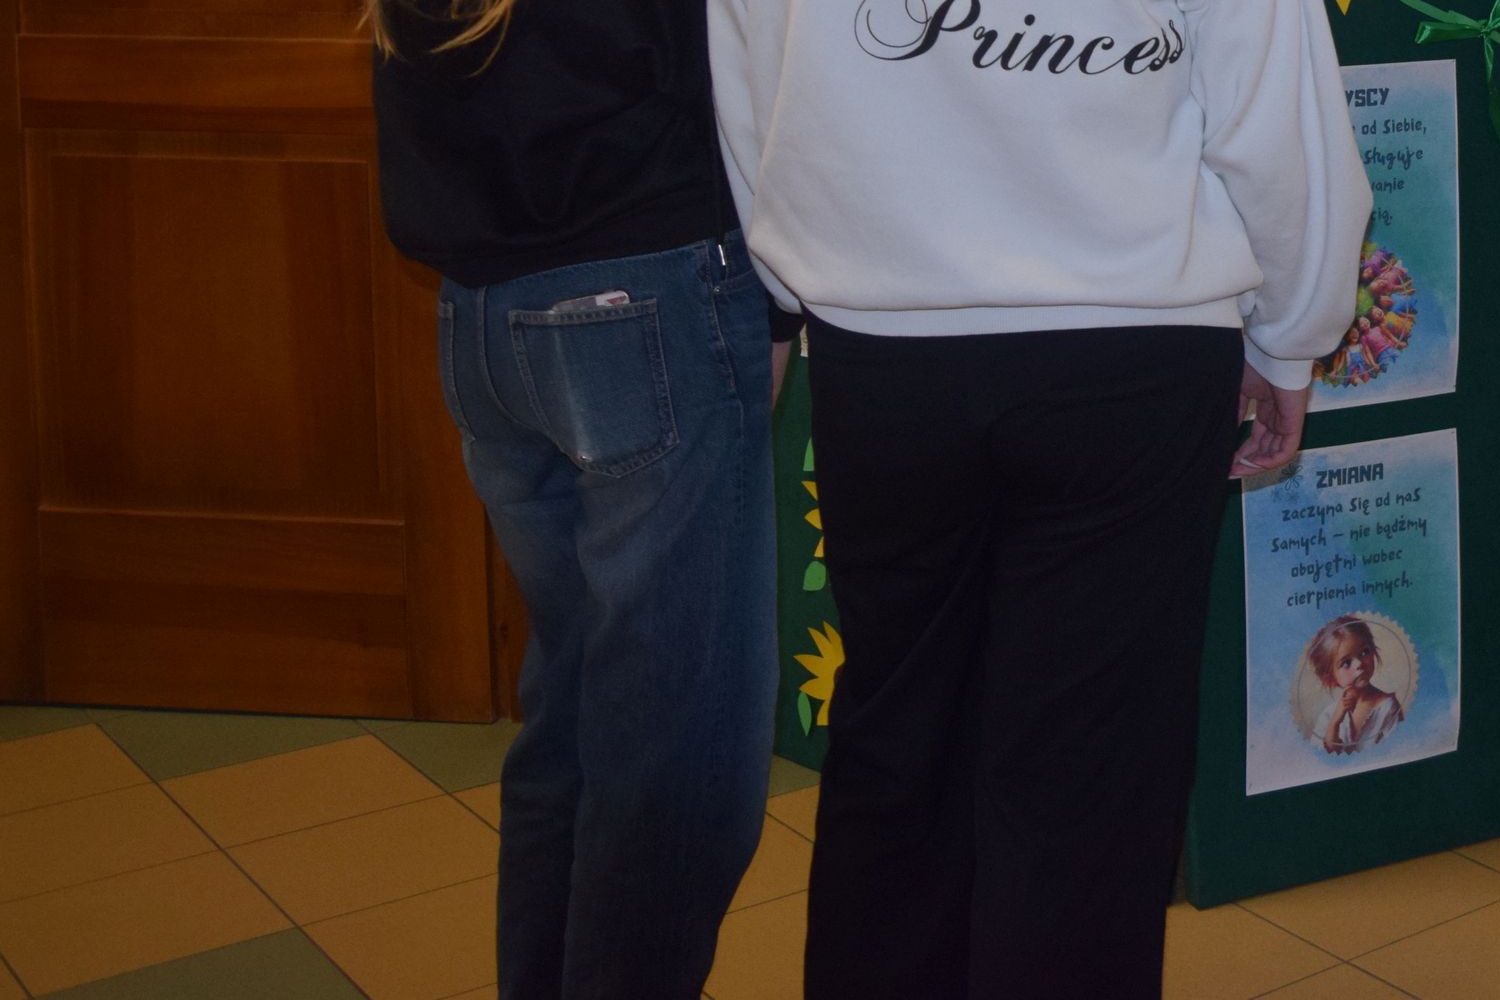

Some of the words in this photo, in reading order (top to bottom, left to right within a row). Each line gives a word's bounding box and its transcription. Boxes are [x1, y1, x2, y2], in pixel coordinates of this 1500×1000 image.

[1344, 88, 1389, 107] YSCY
[1315, 463, 1383, 488] ZMIANA
[1281, 503, 1342, 525] zaczyna
[1375, 492, 1390, 507] od
[1349, 525, 1370, 541] nie
[1376, 515, 1427, 539] bądźmy
[1290, 554, 1356, 583] obojętni
[1361, 549, 1402, 565] wobec
[1286, 584, 1356, 609] cierpienia
[1361, 571, 1413, 598] innych.
